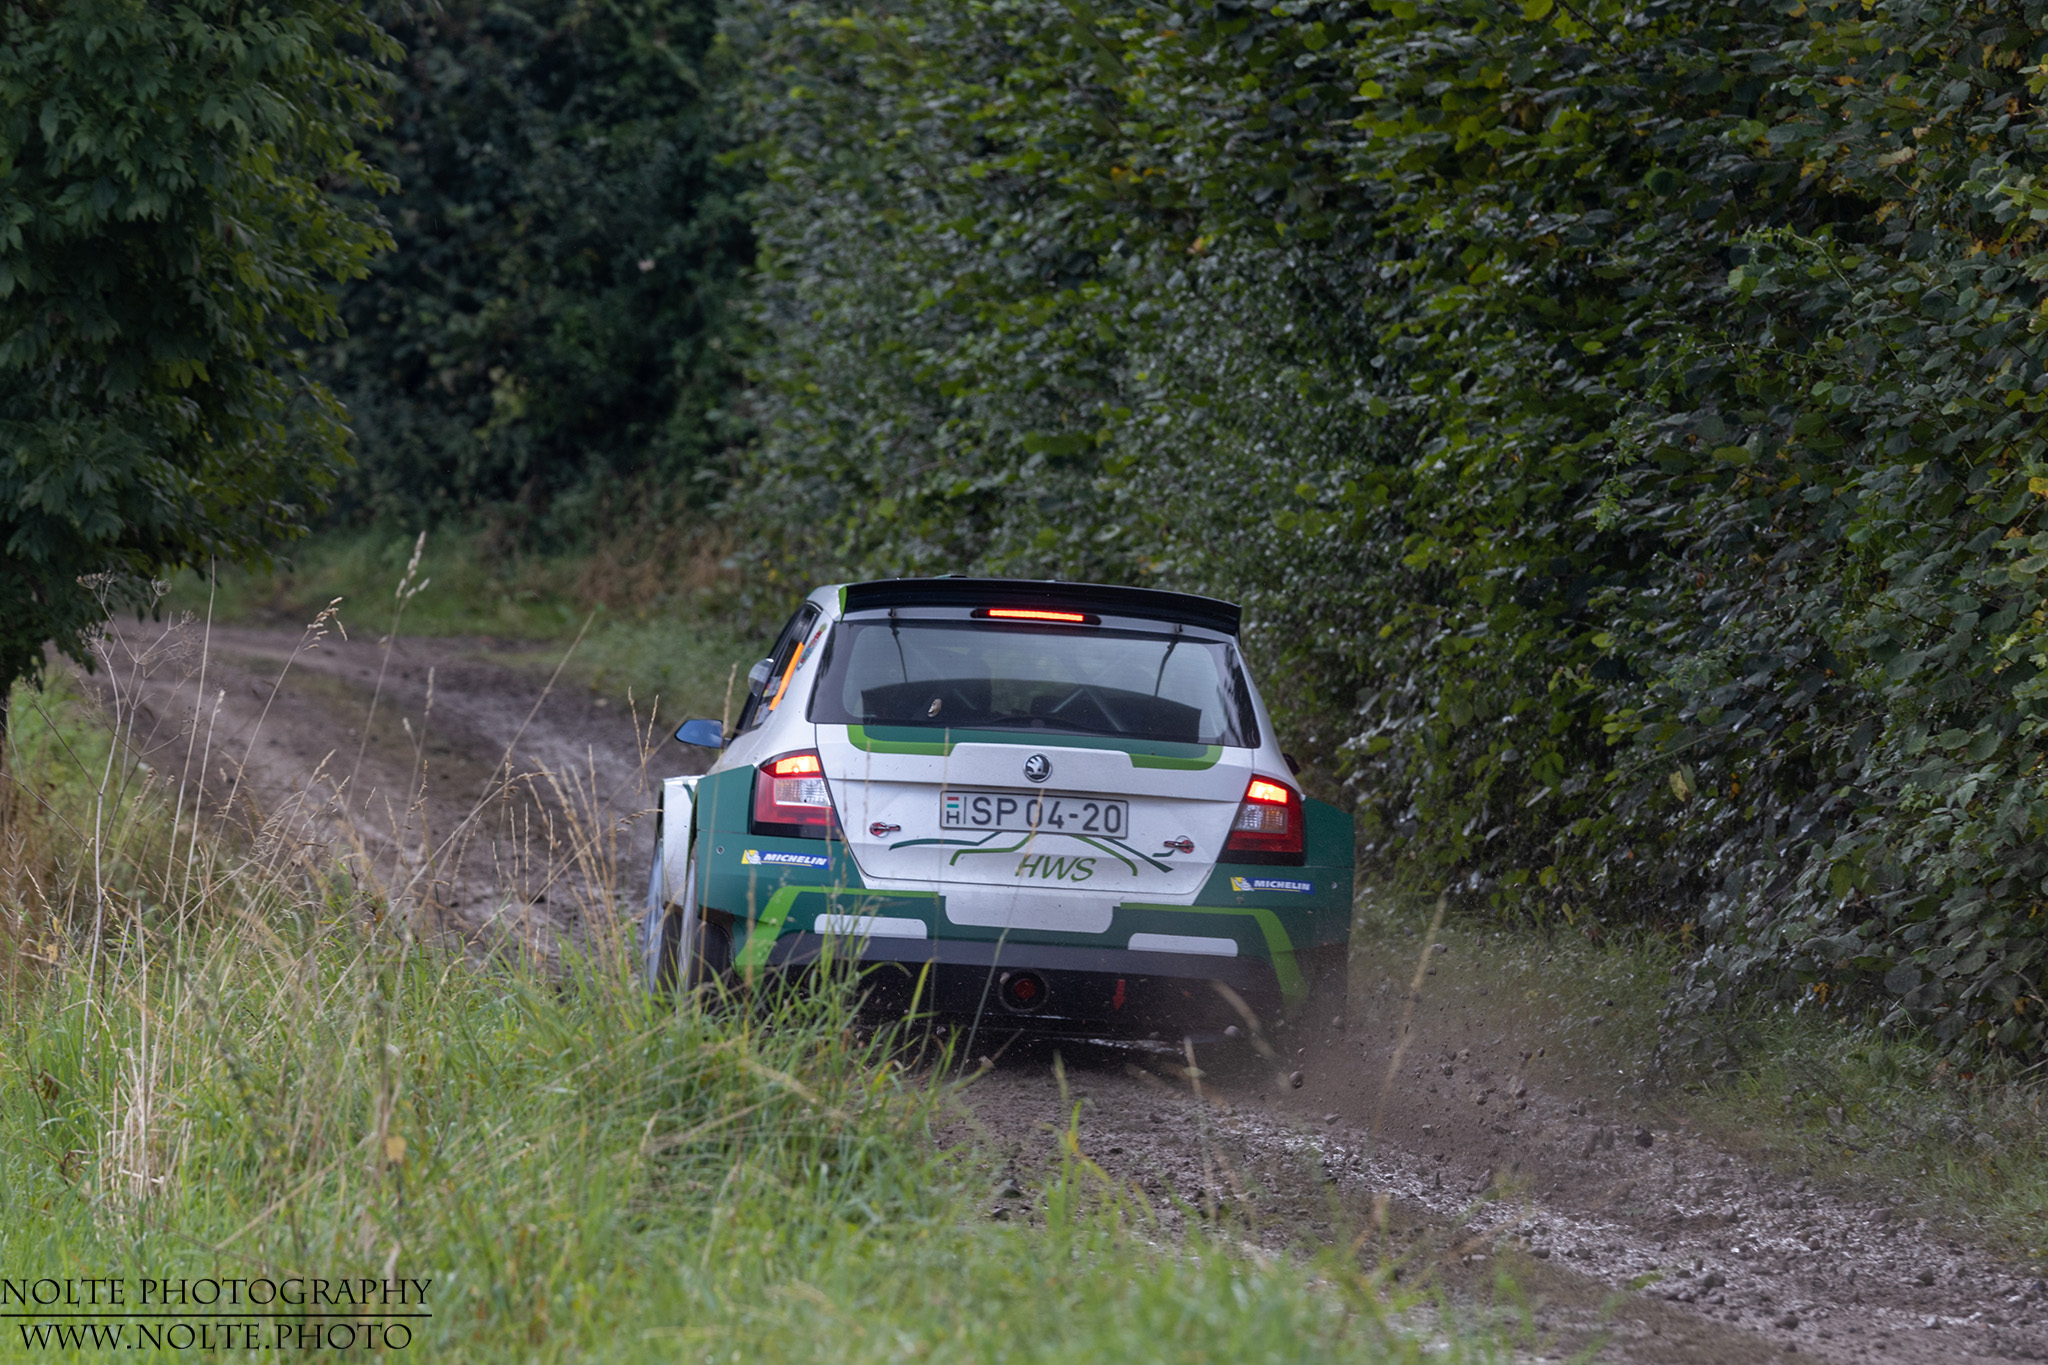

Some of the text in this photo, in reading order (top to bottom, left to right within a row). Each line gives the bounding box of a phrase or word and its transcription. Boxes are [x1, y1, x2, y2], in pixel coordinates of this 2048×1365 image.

[971, 797, 1121, 833] SP 04-20
[763, 853, 828, 866] MICHELIN
[1015, 855, 1097, 882] HWS
[1254, 880, 1311, 891] MICHELIN
